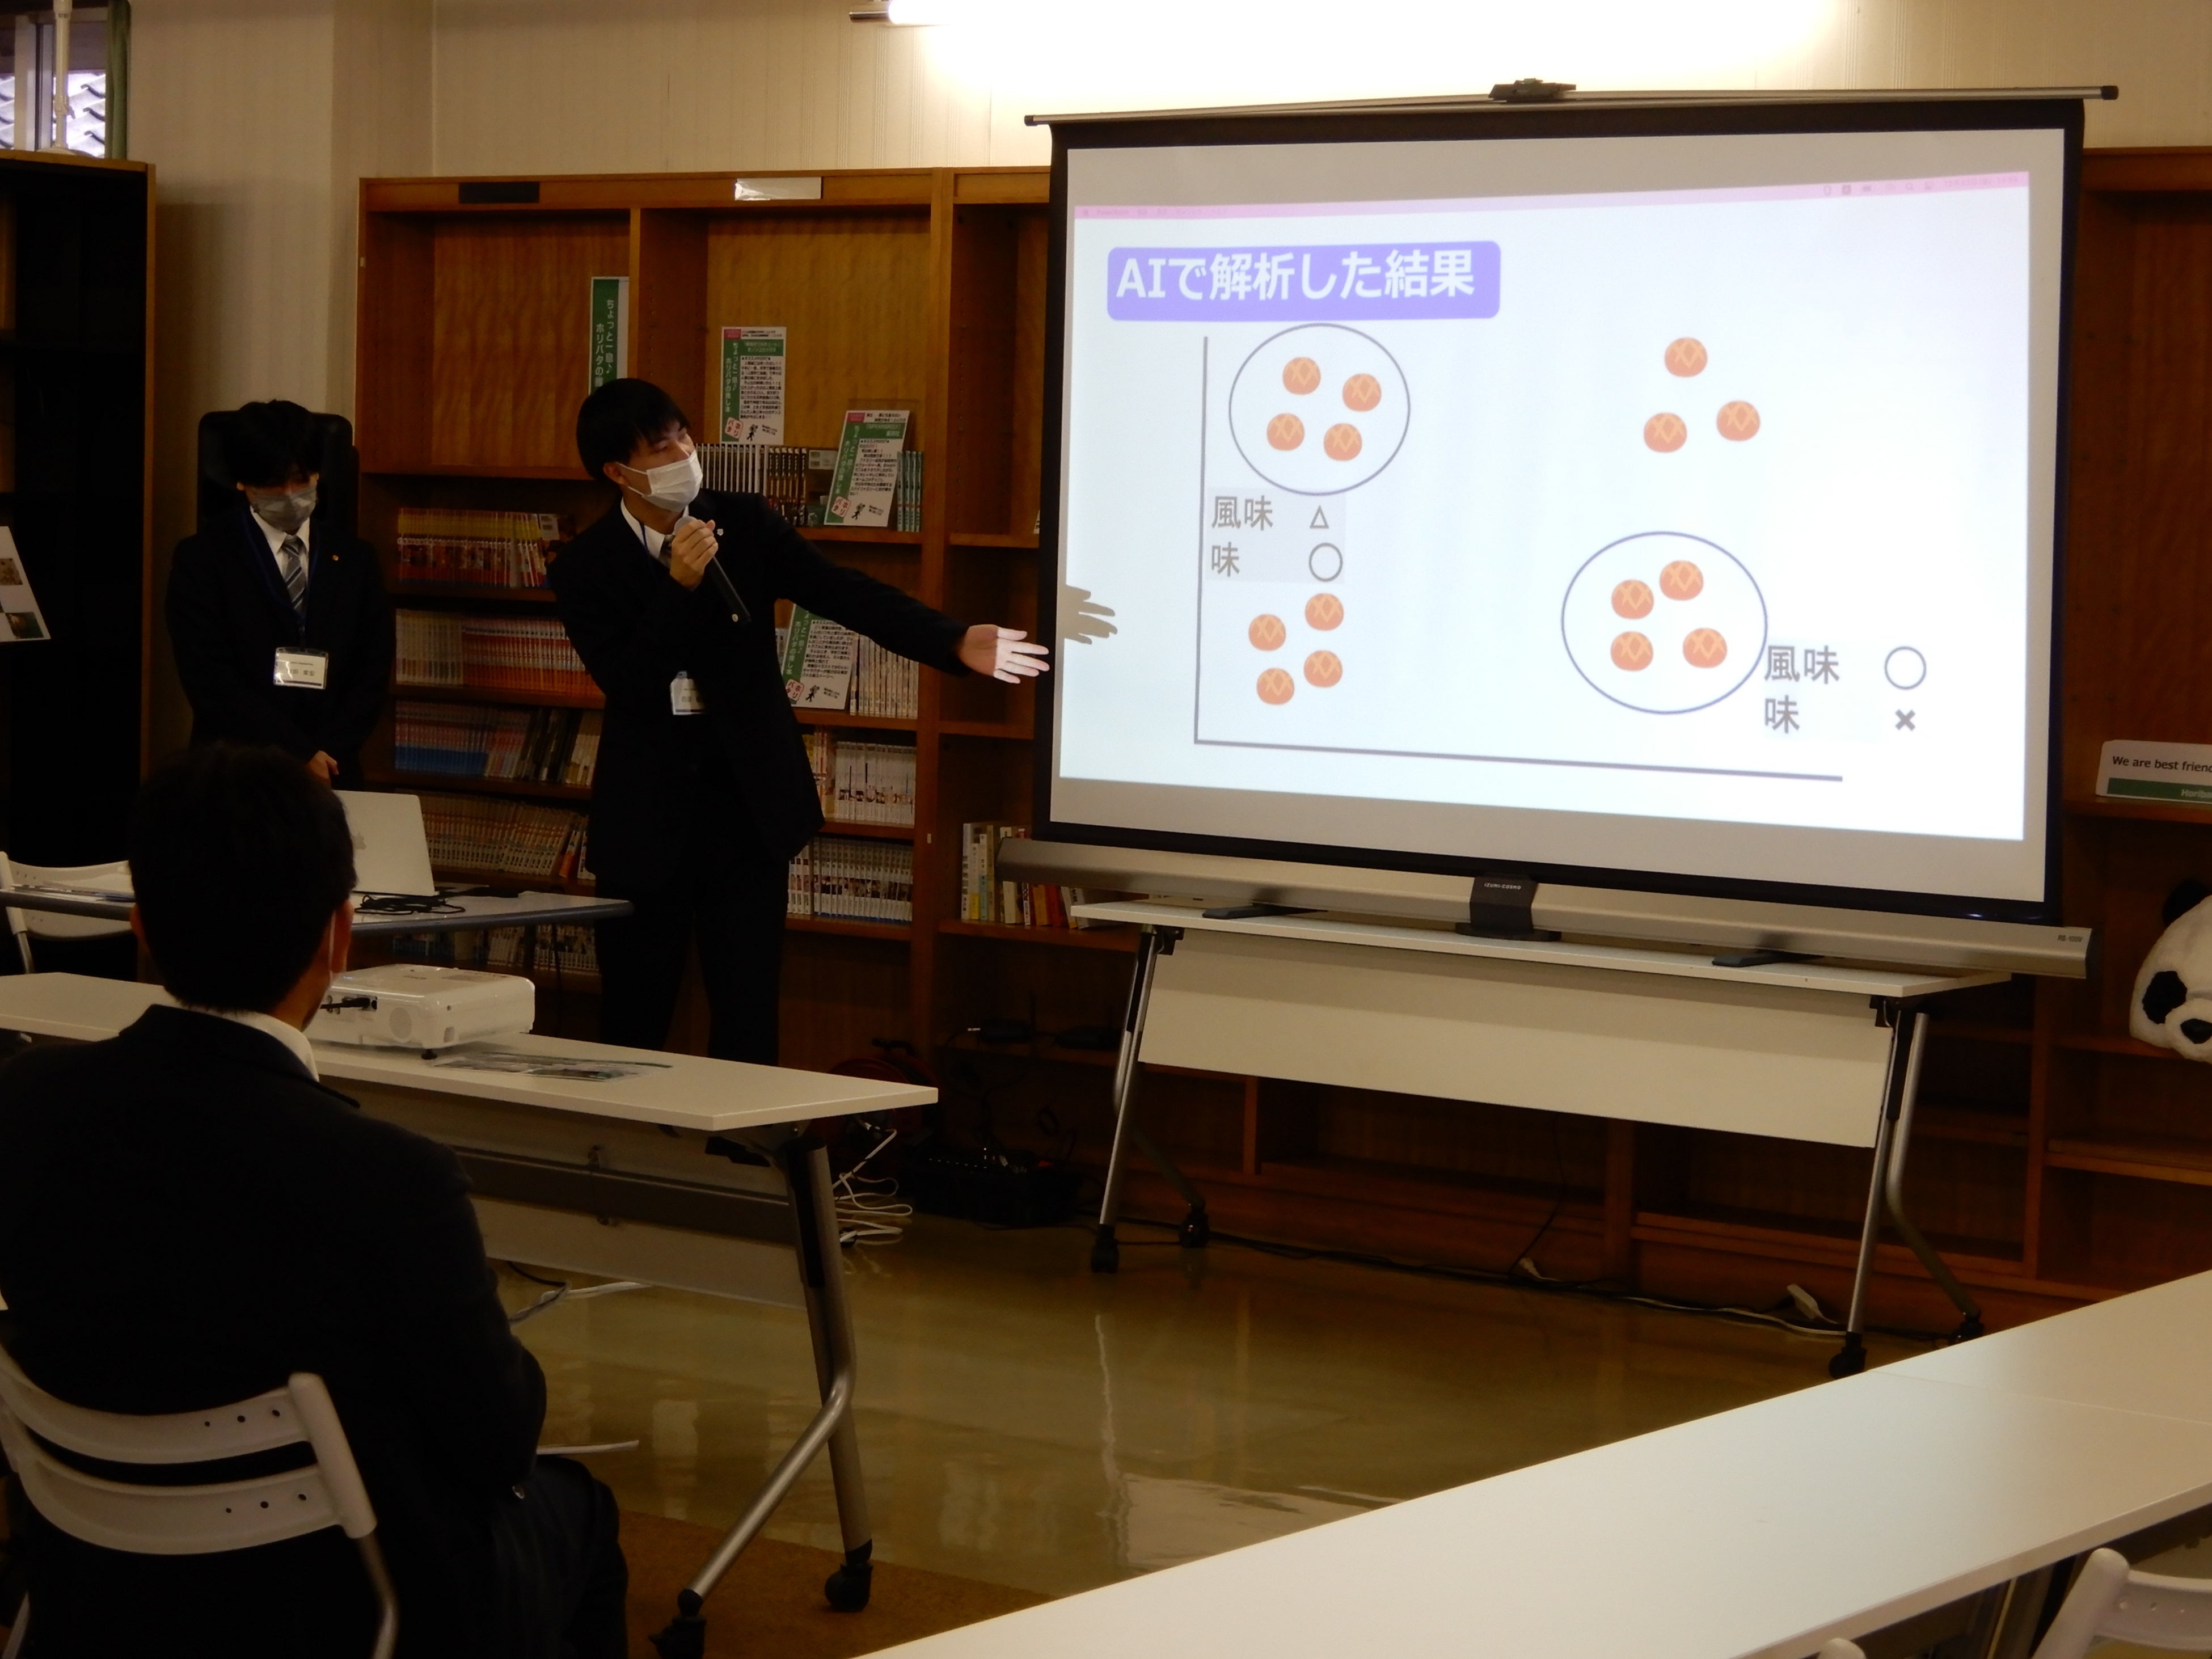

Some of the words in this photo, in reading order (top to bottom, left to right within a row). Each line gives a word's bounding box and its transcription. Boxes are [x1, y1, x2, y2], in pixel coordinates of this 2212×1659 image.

[1116, 249, 1475, 301] AIで解析した結果
[1211, 495, 1273, 531] 風味
[1211, 542, 1240, 577] 味
[1764, 645, 1840, 685] 風味
[1764, 695, 1800, 734] 味
[2113, 755, 2129, 766] We
[2133, 759, 2151, 768] are
[2155, 759, 2179, 770] best
